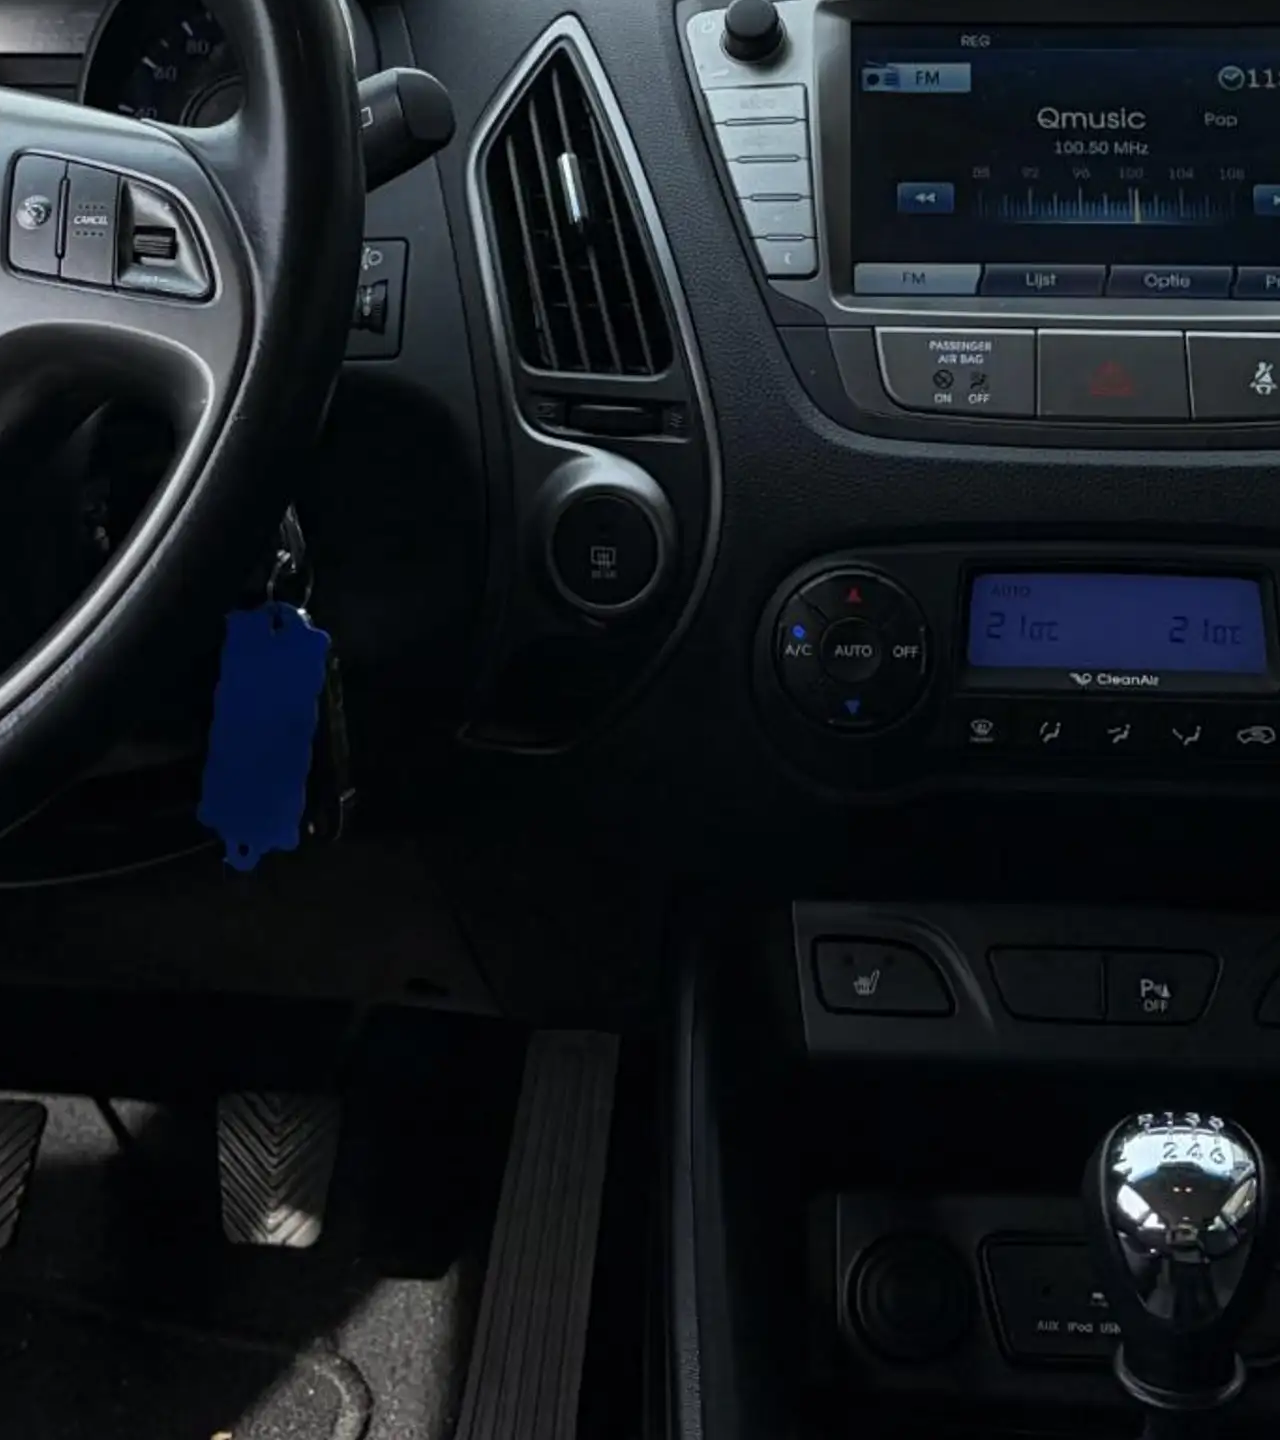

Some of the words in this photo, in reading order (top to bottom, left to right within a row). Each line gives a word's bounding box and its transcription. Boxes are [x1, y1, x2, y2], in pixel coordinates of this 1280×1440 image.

[960, 34, 991, 48] REG
[915, 70, 940, 86] FM
[1037, 106, 1147, 130] Qmusic
[1204, 112, 1238, 127] Pop
[1055, 141, 1109, 155] 100.50
[1114, 141, 1150, 156] MHz
[73, 215, 108, 226] CANCEL
[902, 271, 926, 285] FM
[1025, 271, 1057, 290] Lijst
[1143, 272, 1191, 291] Optie
[929, 340, 992, 352] PASSENGER
[937, 354, 957, 364] AIR
[960, 354, 984, 365] BAG
[934, 393, 952, 404] ON
[968, 393, 991, 404] OFF
[784, 644, 813, 657] A/C
[834, 644, 873, 658] AUTO
[892, 644, 920, 659] OFF
[1096, 672, 1160, 687] CleanAir
[1037, 1320, 1060, 1331] AUX
